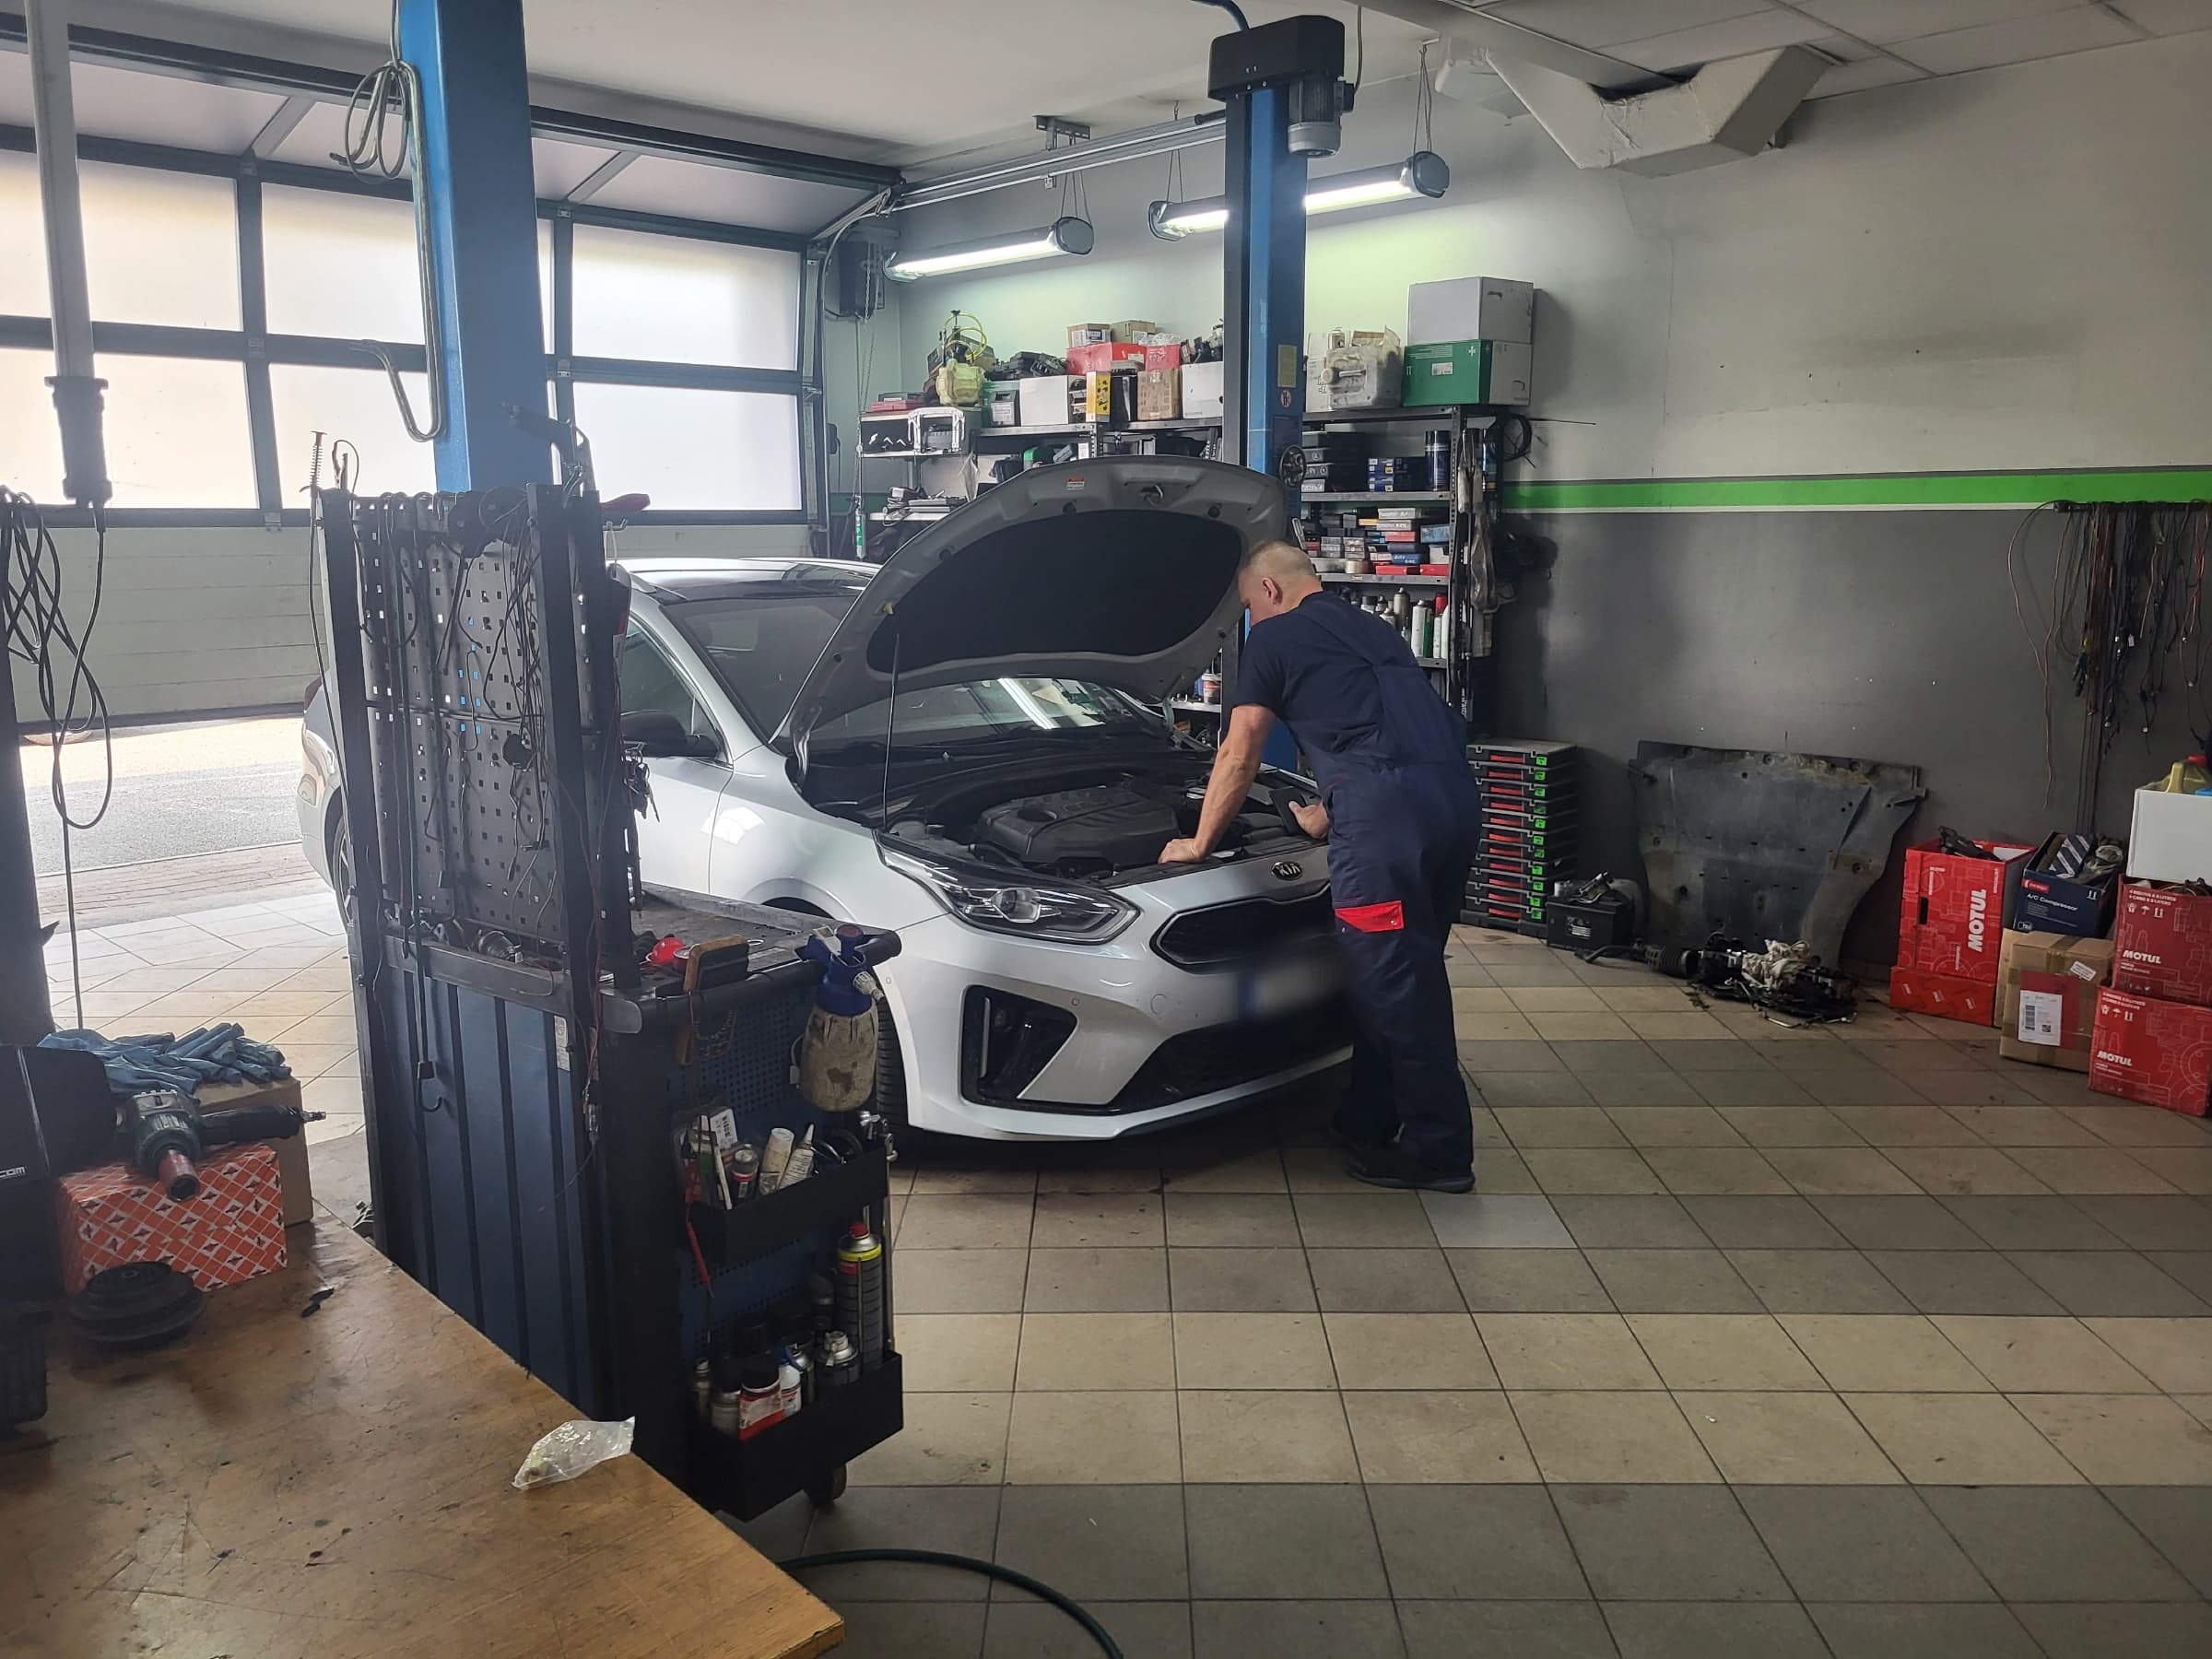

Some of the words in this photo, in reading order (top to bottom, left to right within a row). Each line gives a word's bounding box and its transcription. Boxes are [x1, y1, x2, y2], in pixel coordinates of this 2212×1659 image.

[1968, 888, 1986, 952] MOTUL
[2123, 949, 2161, 964] MOTUL
[2097, 1050, 2133, 1066] MOTUL
